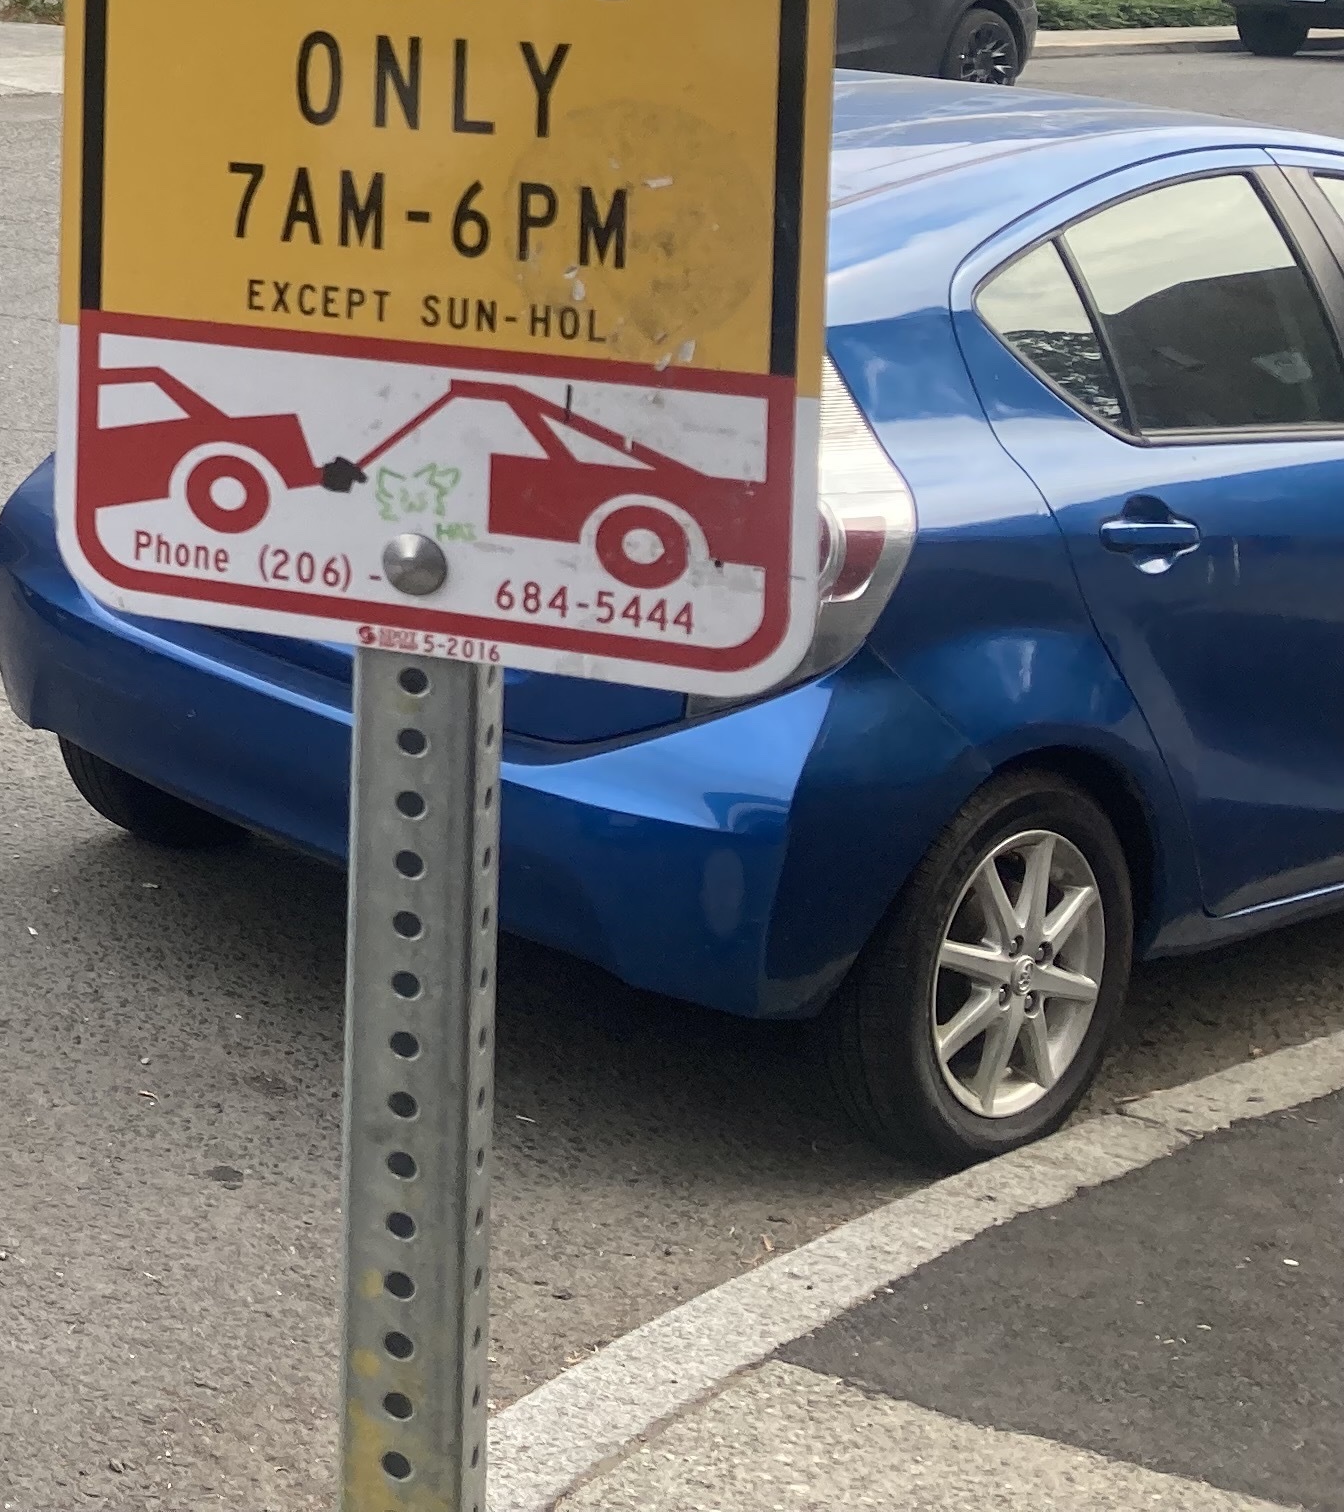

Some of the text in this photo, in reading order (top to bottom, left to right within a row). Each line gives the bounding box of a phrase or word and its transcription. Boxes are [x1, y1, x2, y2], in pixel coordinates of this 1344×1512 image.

[295, 30, 572, 138] ONLY
[228, 161, 628, 270] 7AM-6PM
[247, 279, 607, 343] EXCEPT SUN-HOL
[134, 530, 230, 572] Phone
[496, 579, 694, 635] 684-5444
[424, 634, 500, 662] 5-2016
